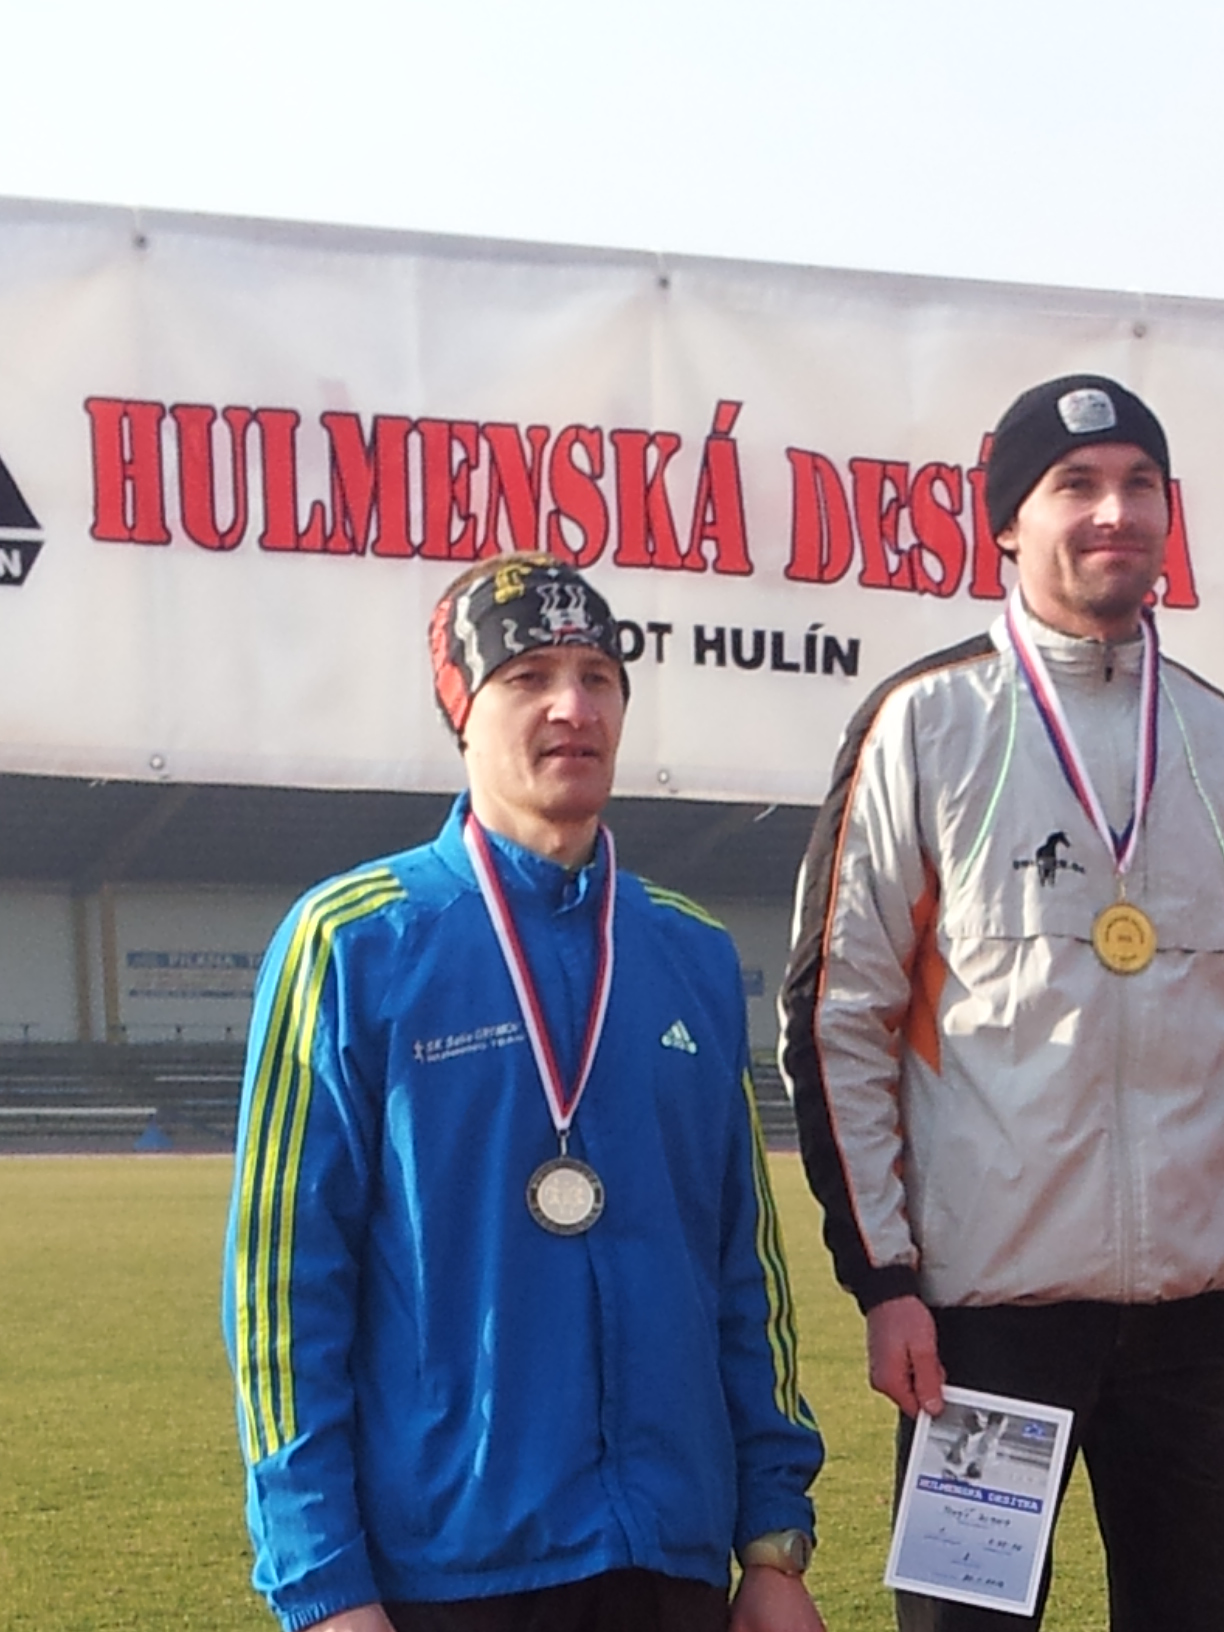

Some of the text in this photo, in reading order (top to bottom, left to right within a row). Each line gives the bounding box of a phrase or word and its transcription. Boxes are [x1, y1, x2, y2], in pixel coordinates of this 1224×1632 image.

[83, 396, 1200, 609] HULMENSKÁ DESÍA
[693, 622, 861, 677] HULÍN
